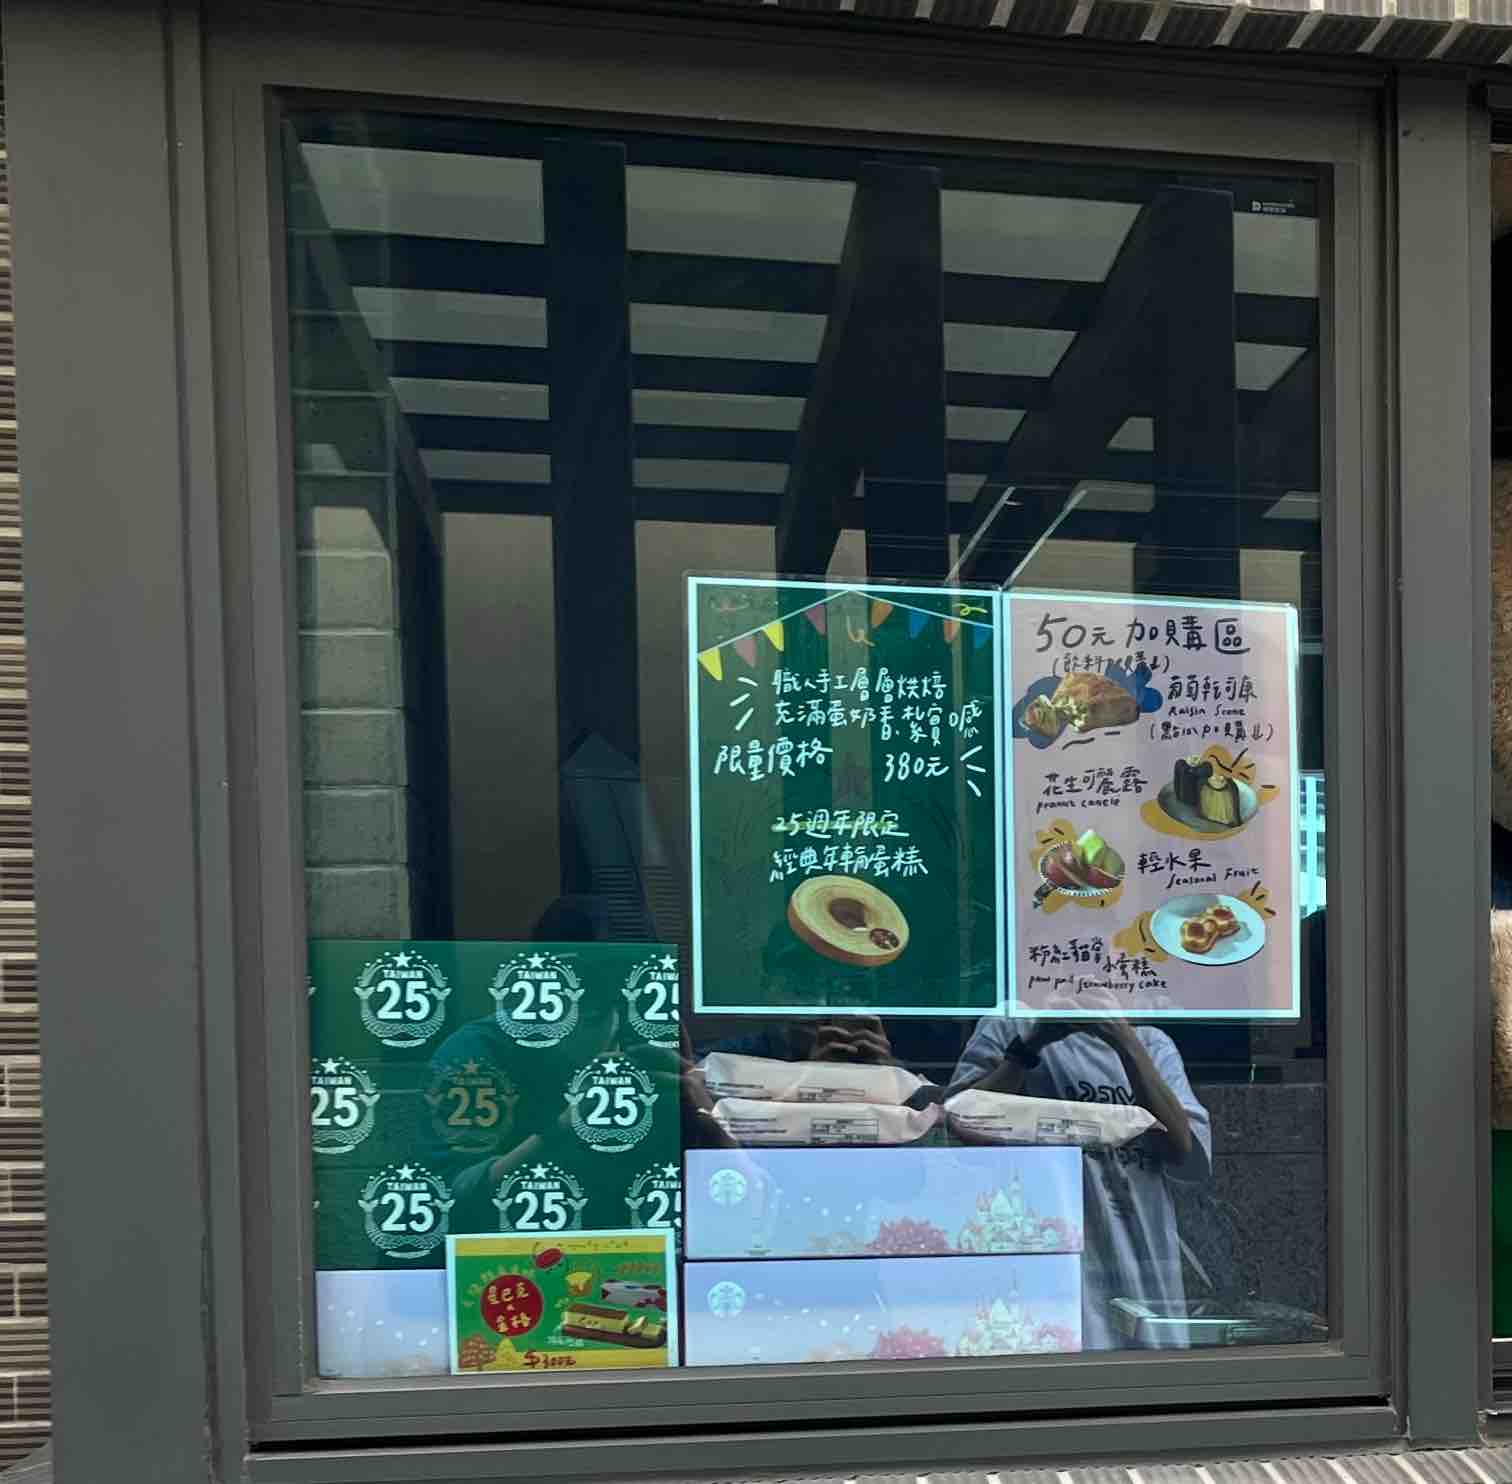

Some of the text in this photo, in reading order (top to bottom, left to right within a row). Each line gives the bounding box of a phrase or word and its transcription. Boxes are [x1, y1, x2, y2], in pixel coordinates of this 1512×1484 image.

[772, 667, 948, 703] 職人手工層層烘焙
[713, 736, 950, 783] 限量價格 380元
[1042, 766, 1149, 796] 花生可麗露
[770, 808, 910, 839] 25週年限定
[769, 843, 929, 883] 經典年輪蛋糕
[376, 979, 430, 1021] 25
[511, 980, 564, 1022] 25
[593, 1076, 632, 1085] TAIWAN
[311, 1086, 359, 1127] 25
[447, 1087, 498, 1127] 25
[586, 1086, 638, 1127] 25
[520, 1180, 561, 1190] TAIWAN
[380, 1191, 434, 1232] 25
[515, 1191, 567, 1230] 25
